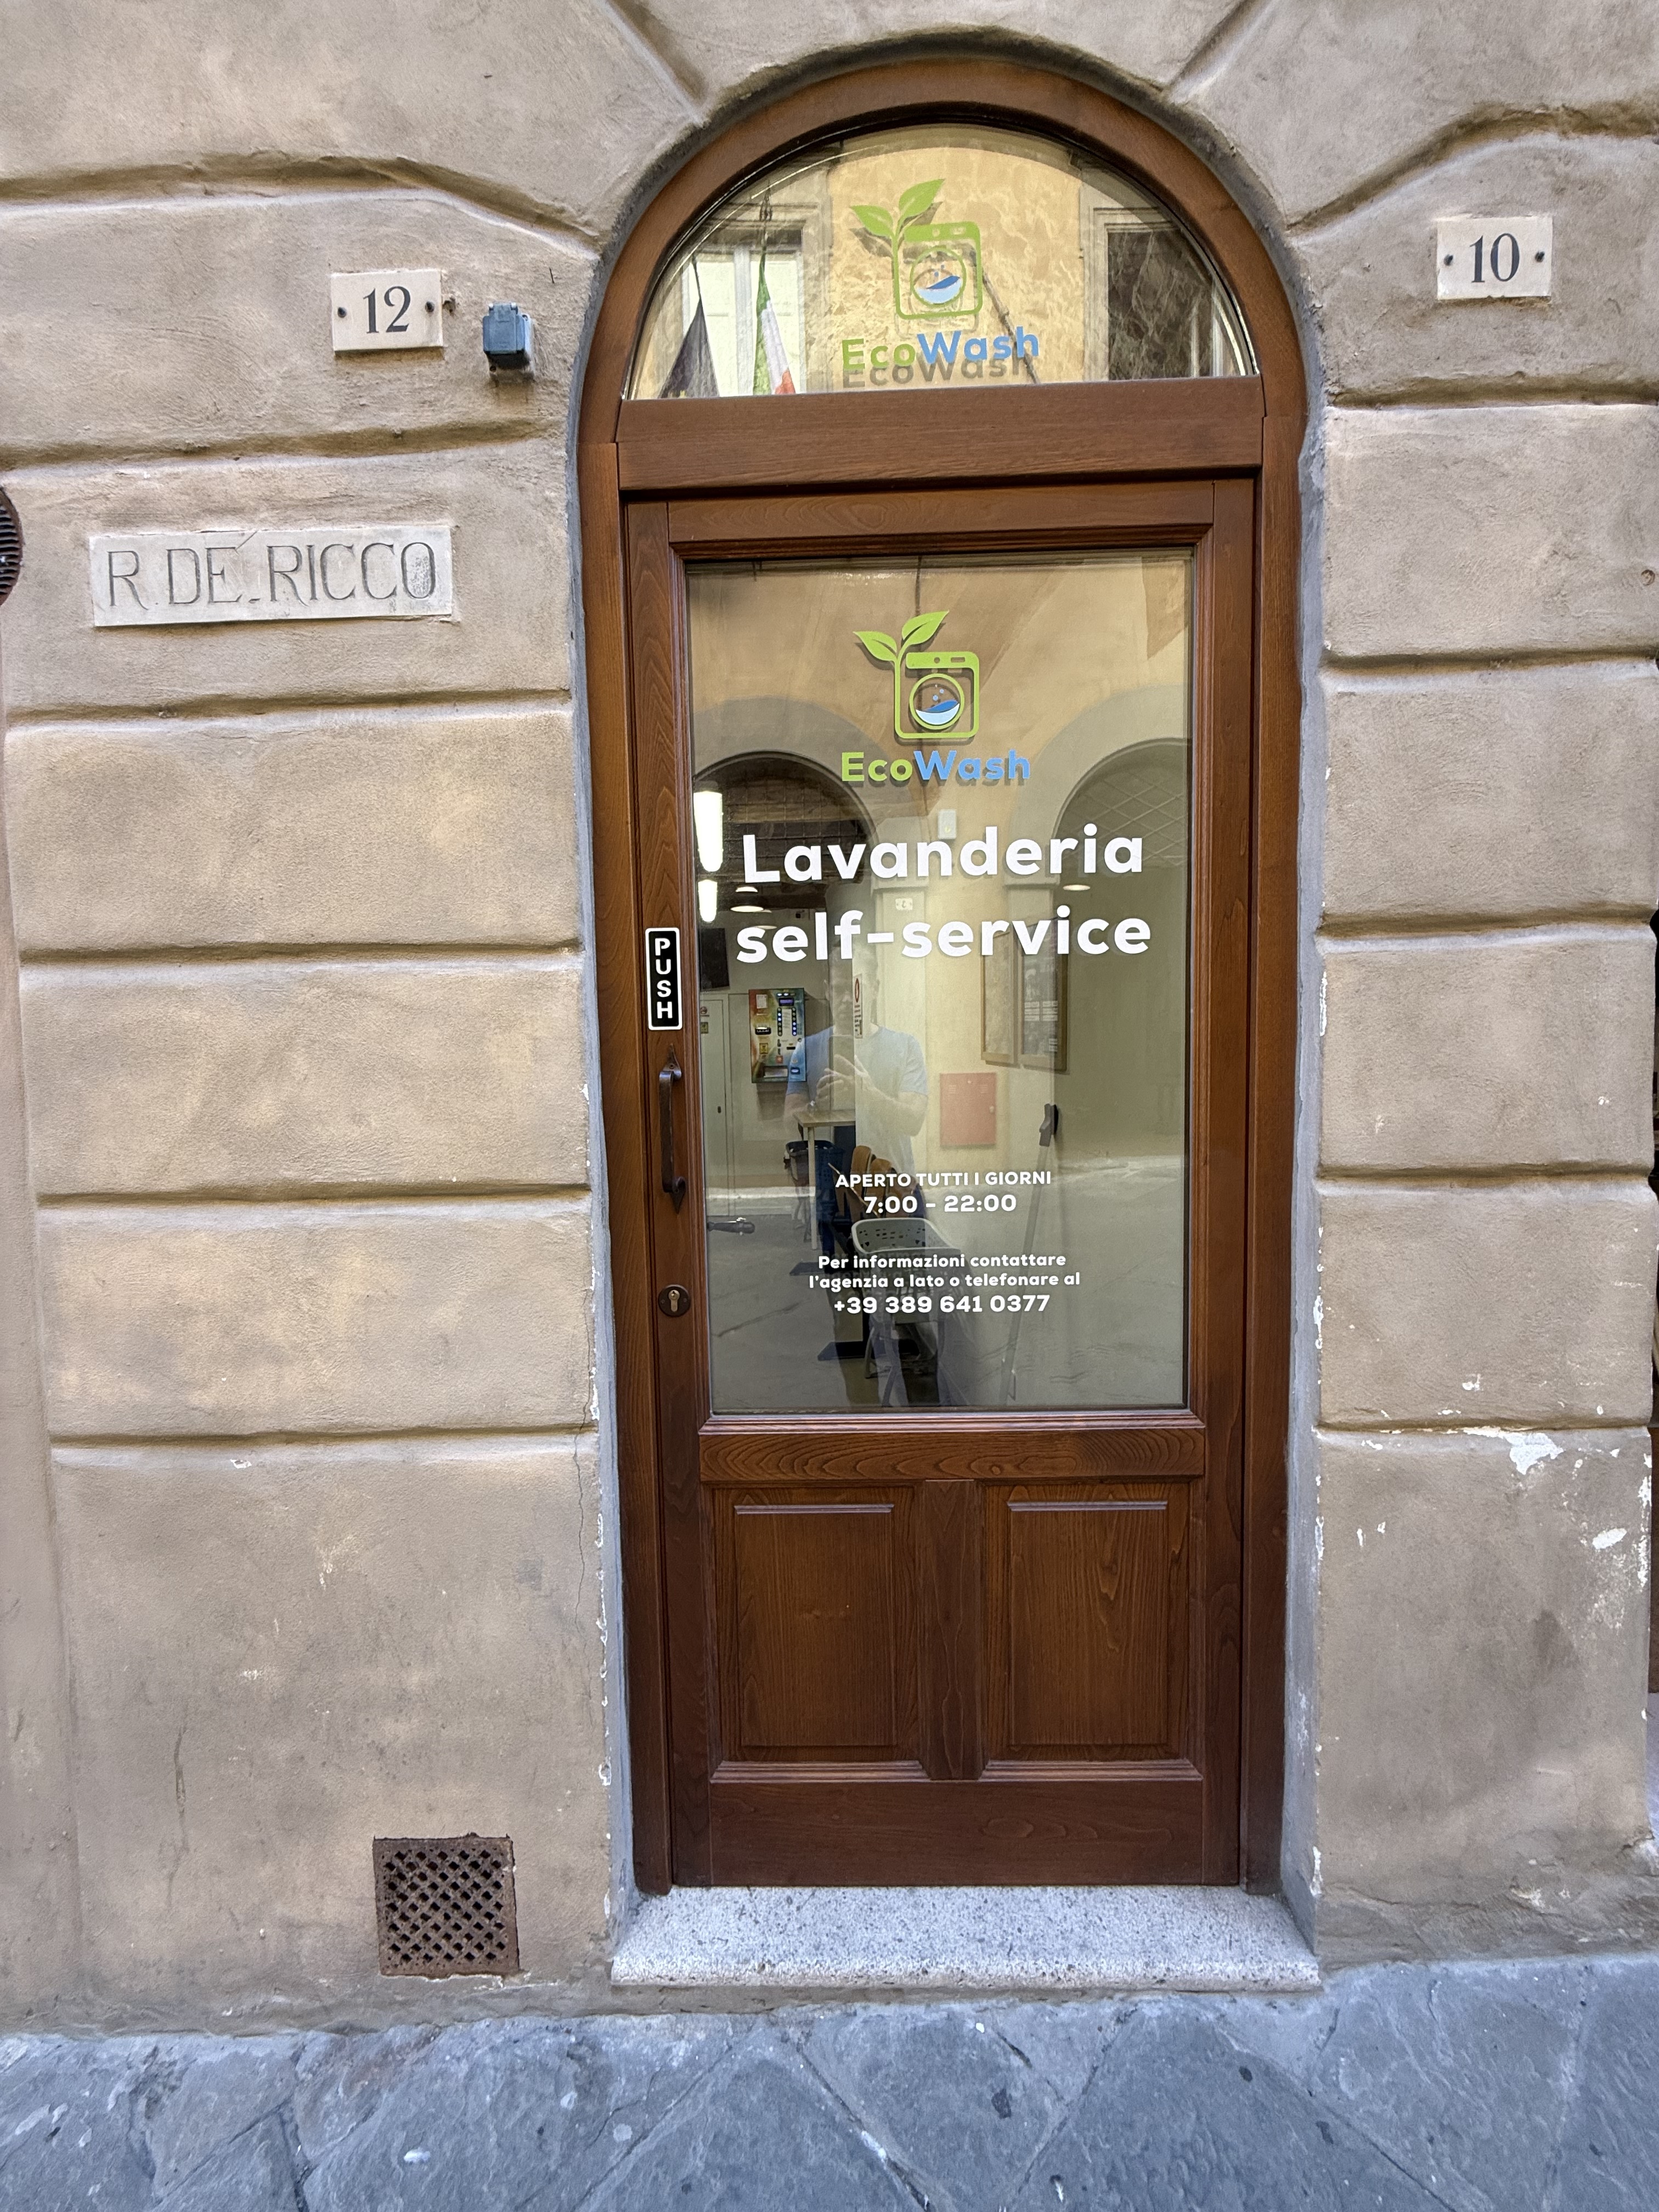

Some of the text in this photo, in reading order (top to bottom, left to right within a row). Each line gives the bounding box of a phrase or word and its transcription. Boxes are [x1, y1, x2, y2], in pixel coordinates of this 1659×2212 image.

[1470, 233, 1520, 283] 10
[363, 286, 411, 334] 12
[842, 326, 1039, 370] EcoWash
[267, 542, 436, 606] RICCO
[841, 749, 1030, 782] EcoWash
[743, 823, 1143, 883] Lavanderia
[736, 905, 1151, 963] self-service
[654, 938, 673, 1019] PUSH
[835, 1171, 1051, 1188] APERTO TUTTI I GIORNI
[864, 1196, 918, 1214] 7:00
[944, 1194, 1017, 1212] 22:00
[809, 1272, 1080, 1293] l'agenzia a lato o telefonare al
[819, 1254, 1066, 1269] Per informazioni contattare
[834, 1294, 1050, 1314] +39 389 641 0377
